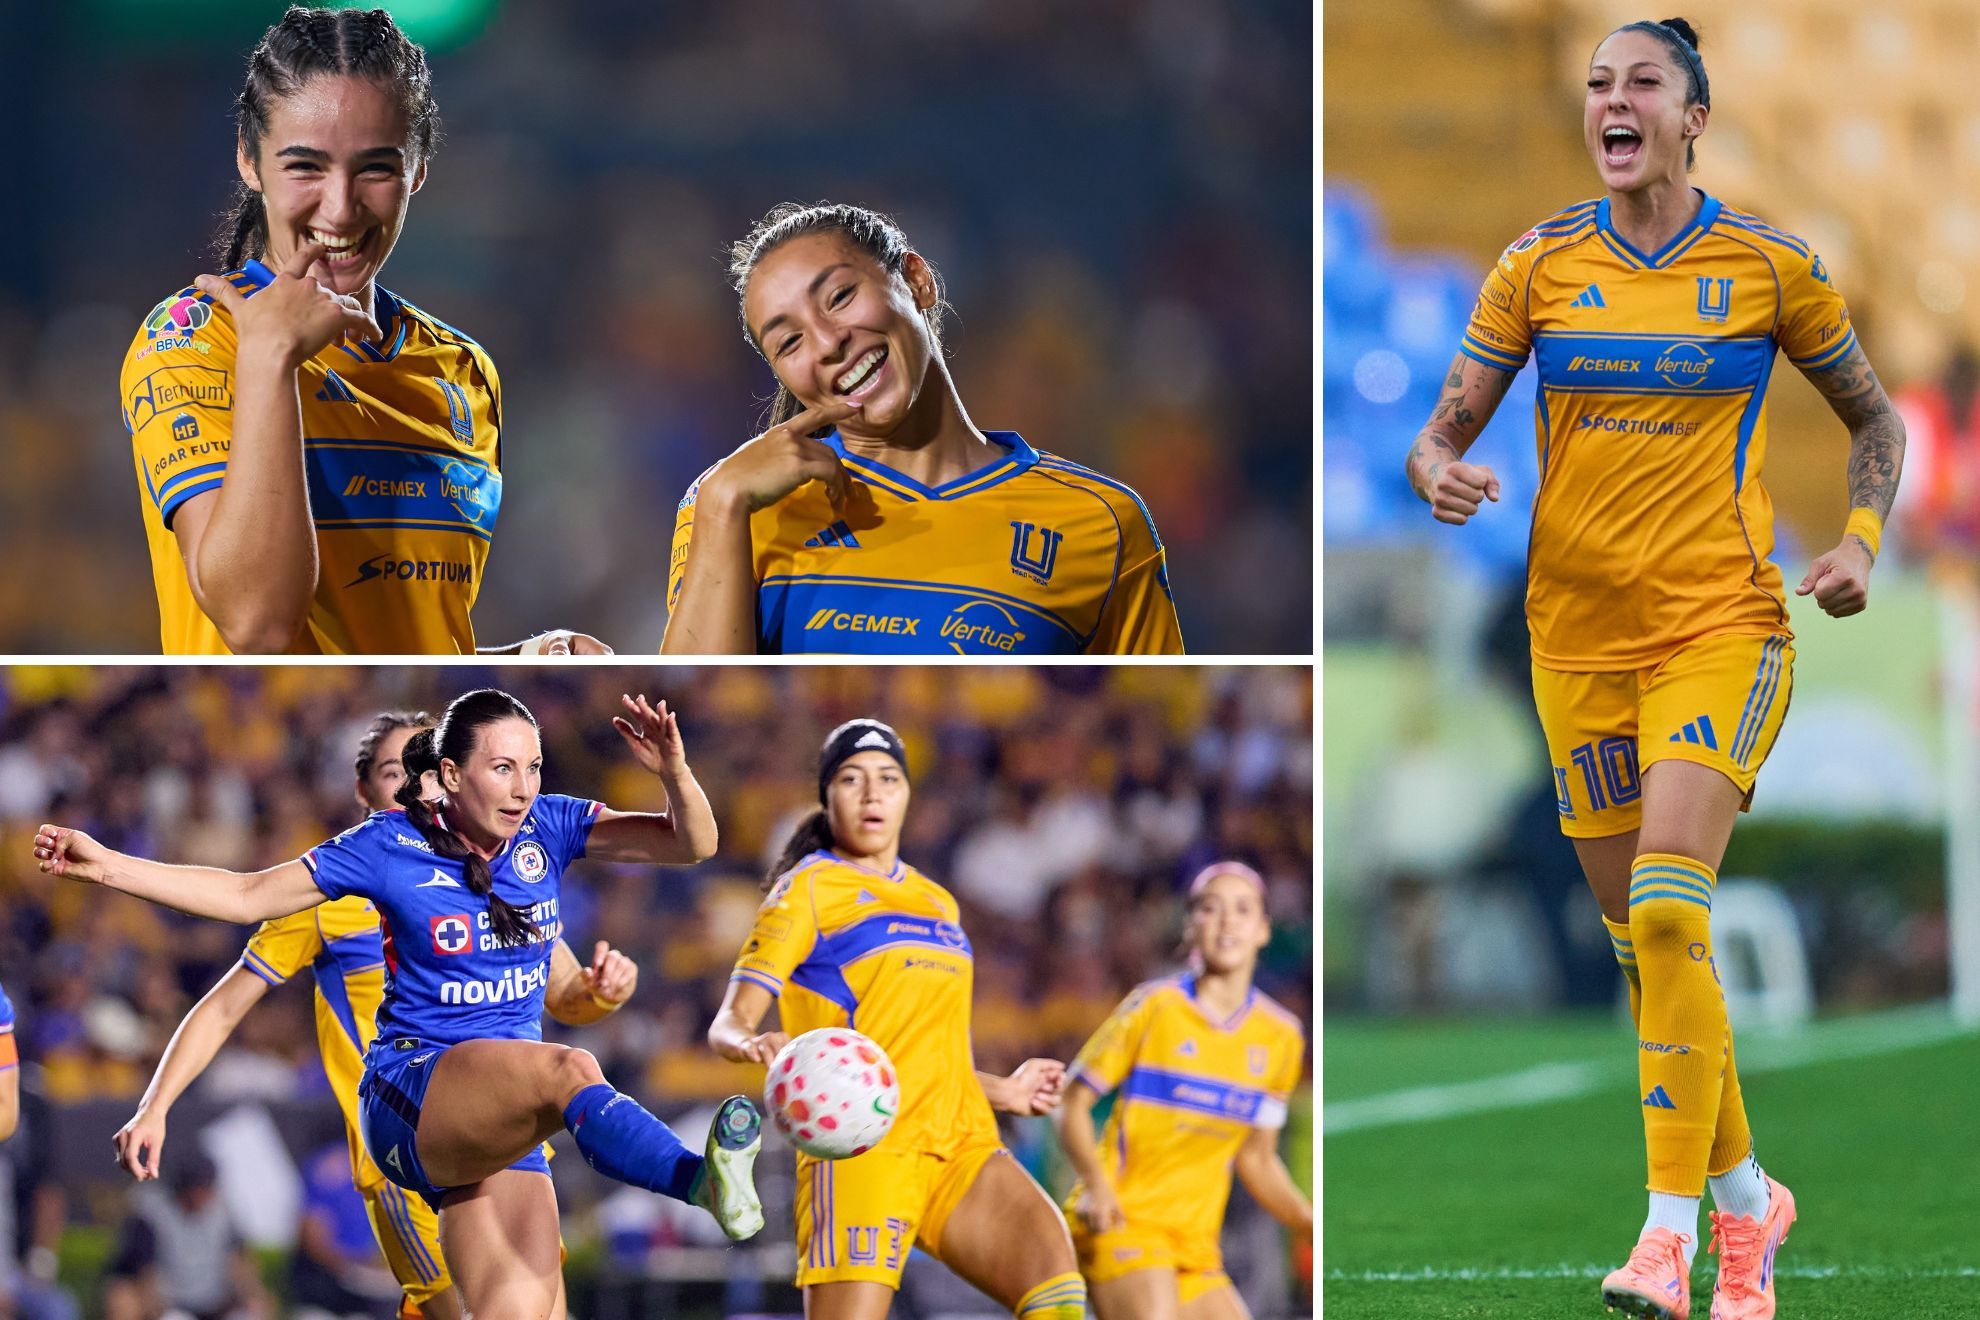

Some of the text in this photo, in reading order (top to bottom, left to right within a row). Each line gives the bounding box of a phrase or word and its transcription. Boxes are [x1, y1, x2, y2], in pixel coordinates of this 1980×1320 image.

[156, 338, 192, 352] BBVA
[1583, 356, 1708, 374] CEMEX Vertua
[155, 381, 224, 404] Ternium
[174, 423, 197, 440] HF
[153, 448, 187, 479] OGAR
[366, 480, 427, 498] CEMEX
[832, 612, 1017, 652] CEMEX Vertua
[1570, 736, 1642, 811] 10
[440, 960, 546, 1004] novibet
